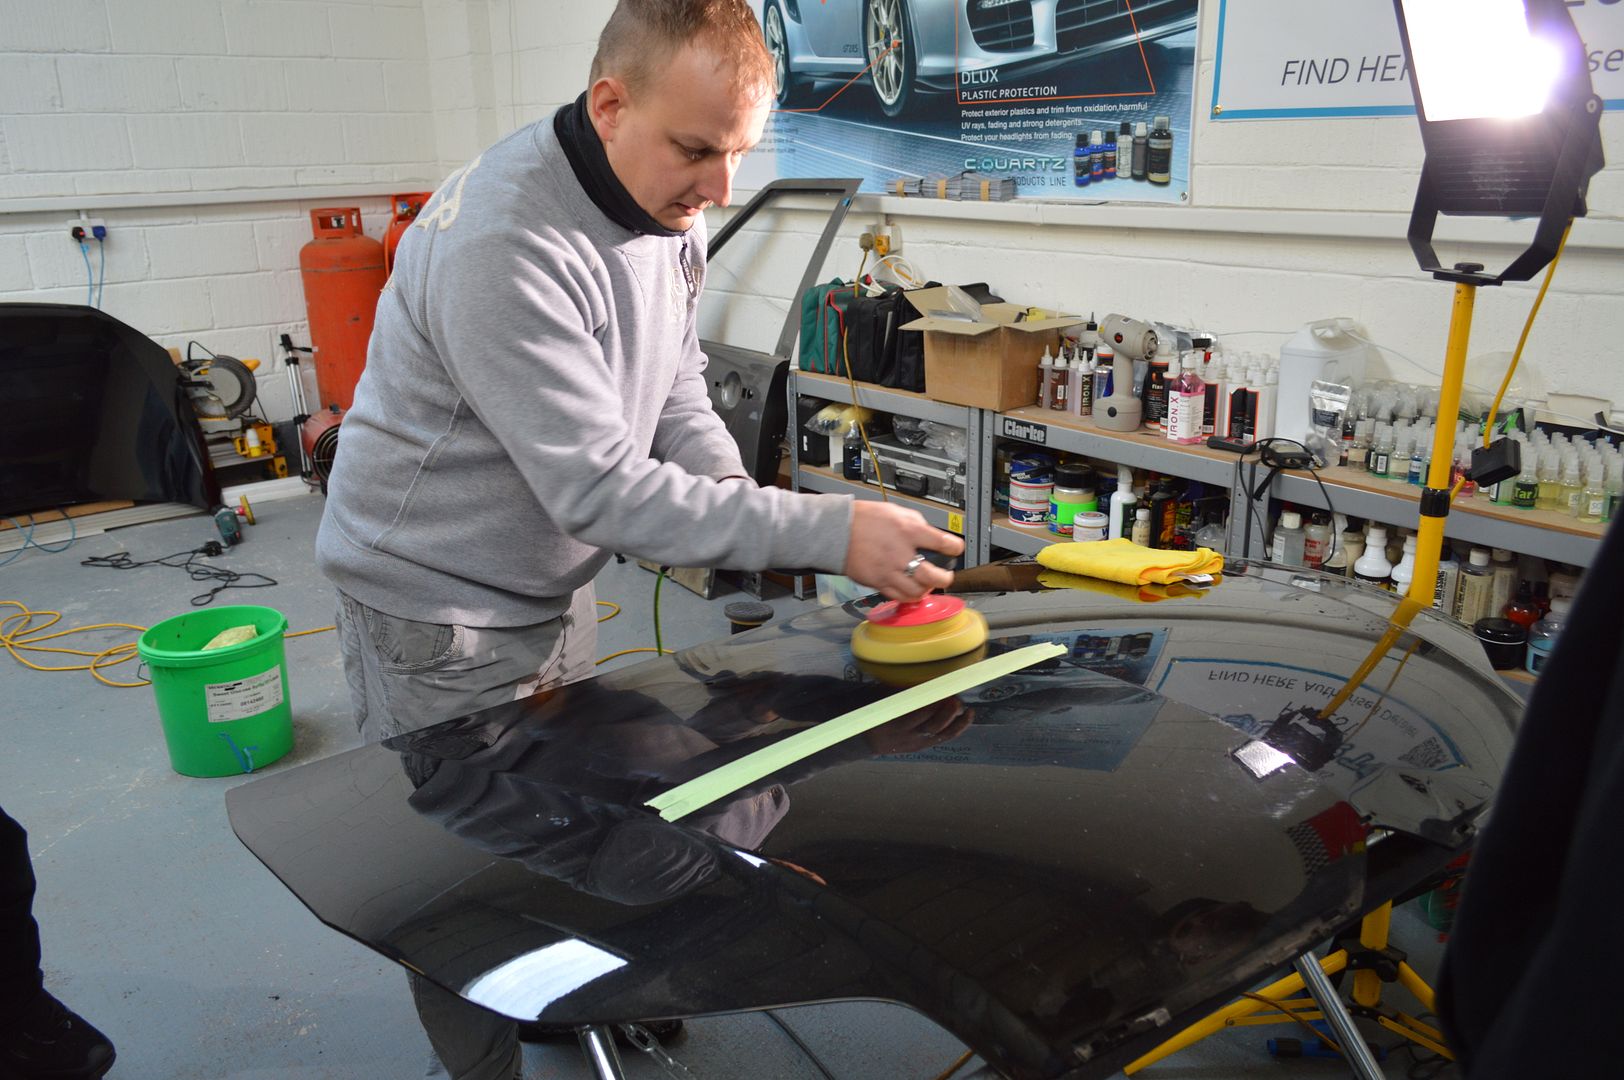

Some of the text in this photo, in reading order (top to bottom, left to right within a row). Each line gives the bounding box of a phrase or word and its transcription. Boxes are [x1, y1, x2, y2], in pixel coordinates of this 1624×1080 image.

[1281, 57, 1350, 86] FIND
[1357, 54, 1409, 83] HE
[961, 69, 999, 85] DLUX
[961, 86, 1058, 101] PLASTIC PROTECTION
[961, 110, 984, 118] Protect
[985, 109, 1009, 117] exterior
[1010, 108, 1035, 117] plastics
[1036, 107, 1050, 115] and
[1051, 106, 1065, 114] trim
[1066, 105, 1083, 113] from
[961, 122, 971, 130] UV
[988, 121, 1007, 130] fading
[1008, 121, 1022, 129] and
[1022, 120, 1044, 129] strong
[960, 133, 984, 142] Protect
[984, 134, 999, 143] your
[999, 132, 1033, 142] headlights
[1033, 132, 1050, 140] from
[964, 157, 1066, 170] C.QUARTZ
[1049, 176, 1067, 187] LINE
[1082, 384, 1090, 406] IRON
[1004, 420, 1045, 443] Clarke
[1515, 488, 1532, 500] Tar
